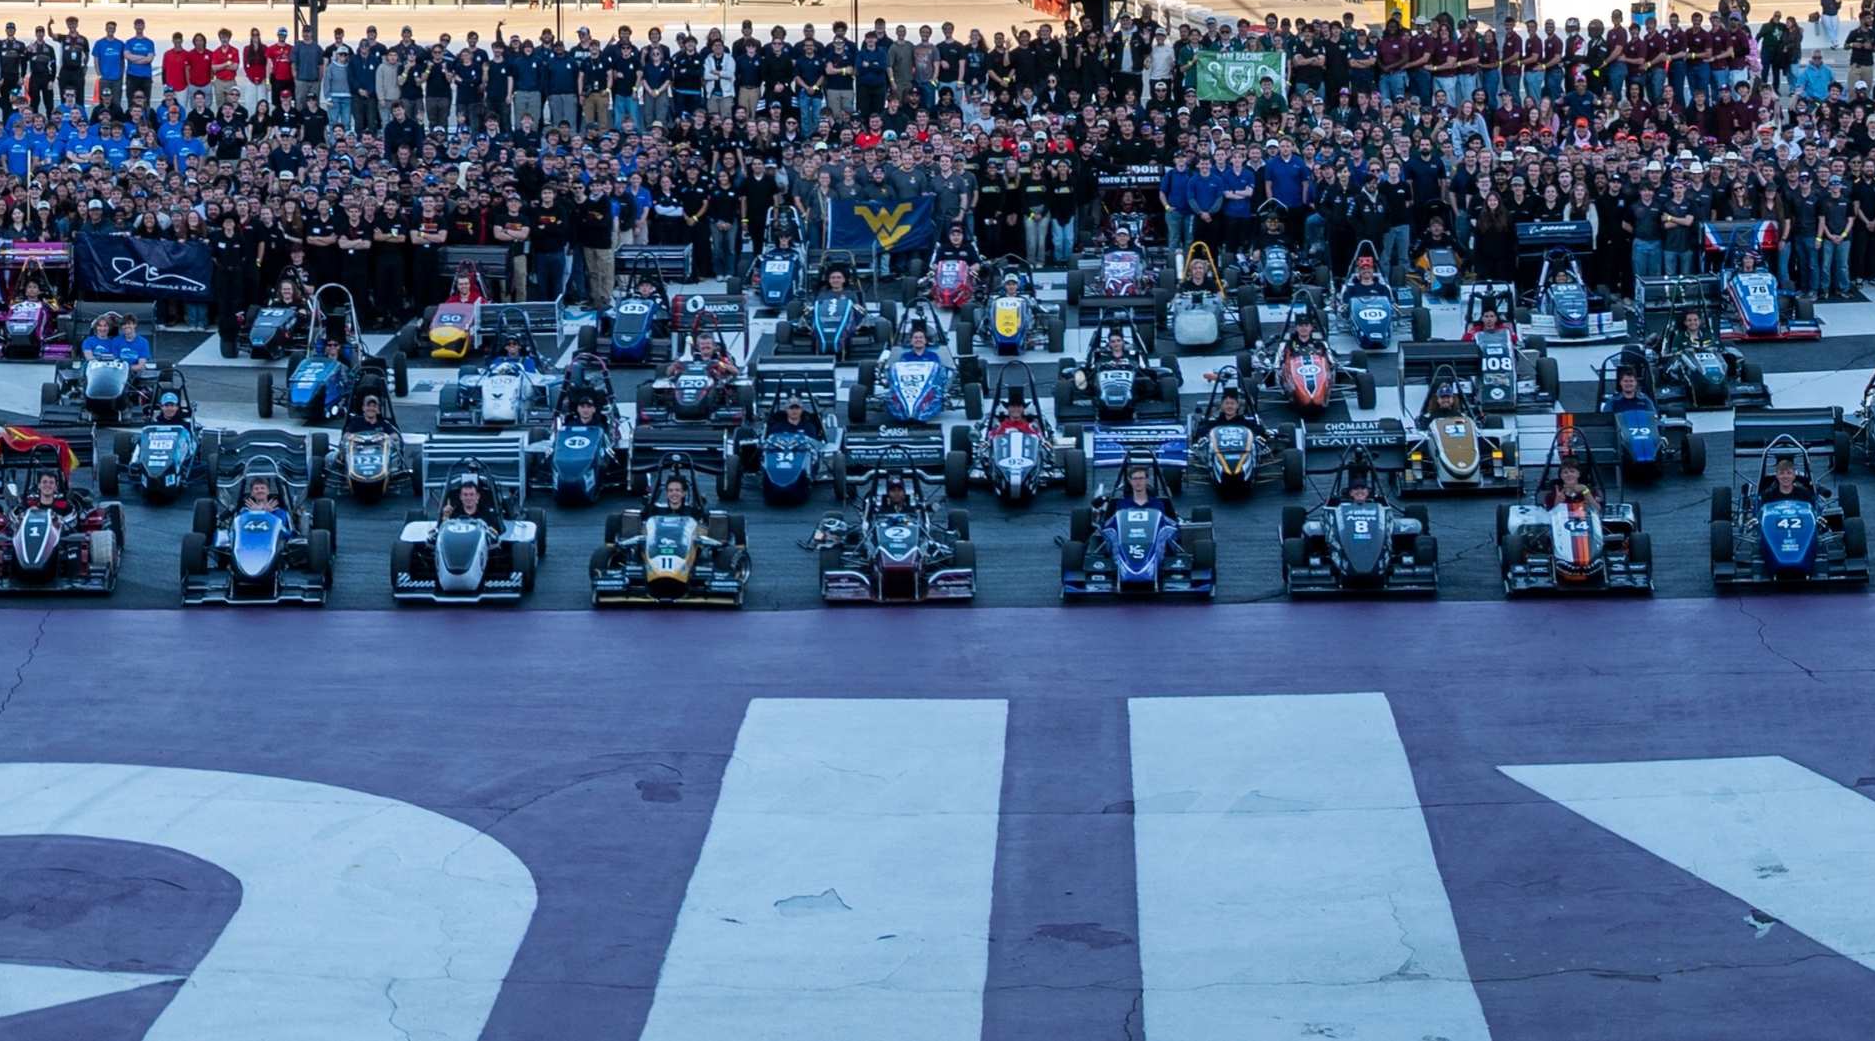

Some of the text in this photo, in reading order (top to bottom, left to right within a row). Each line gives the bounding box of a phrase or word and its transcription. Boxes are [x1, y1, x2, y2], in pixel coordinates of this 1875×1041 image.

[1235, 52, 1263, 62] RACING
[1751, 285, 1767, 294] 76
[262, 308, 283, 317] 75
[704, 304, 739, 313] MAKINO
[440, 314, 461, 322] 50
[1362, 310, 1382, 319] 101
[1482, 357, 1512, 372] 108
[678, 378, 704, 388] 120
[879, 424, 909, 437] SMASH
[1324, 422, 1380, 431] CHOMARAT
[1628, 427, 1651, 435] 79
[776, 451, 794, 461] 34
[244, 520, 269, 530] 44
[1355, 521, 1369, 533] 8
[1568, 521, 1588, 531] 14
[1777, 518, 1801, 529] 42
[28, 526, 40, 537] 1
[891, 528, 905, 537] 2
[660, 557, 673, 569] 11
